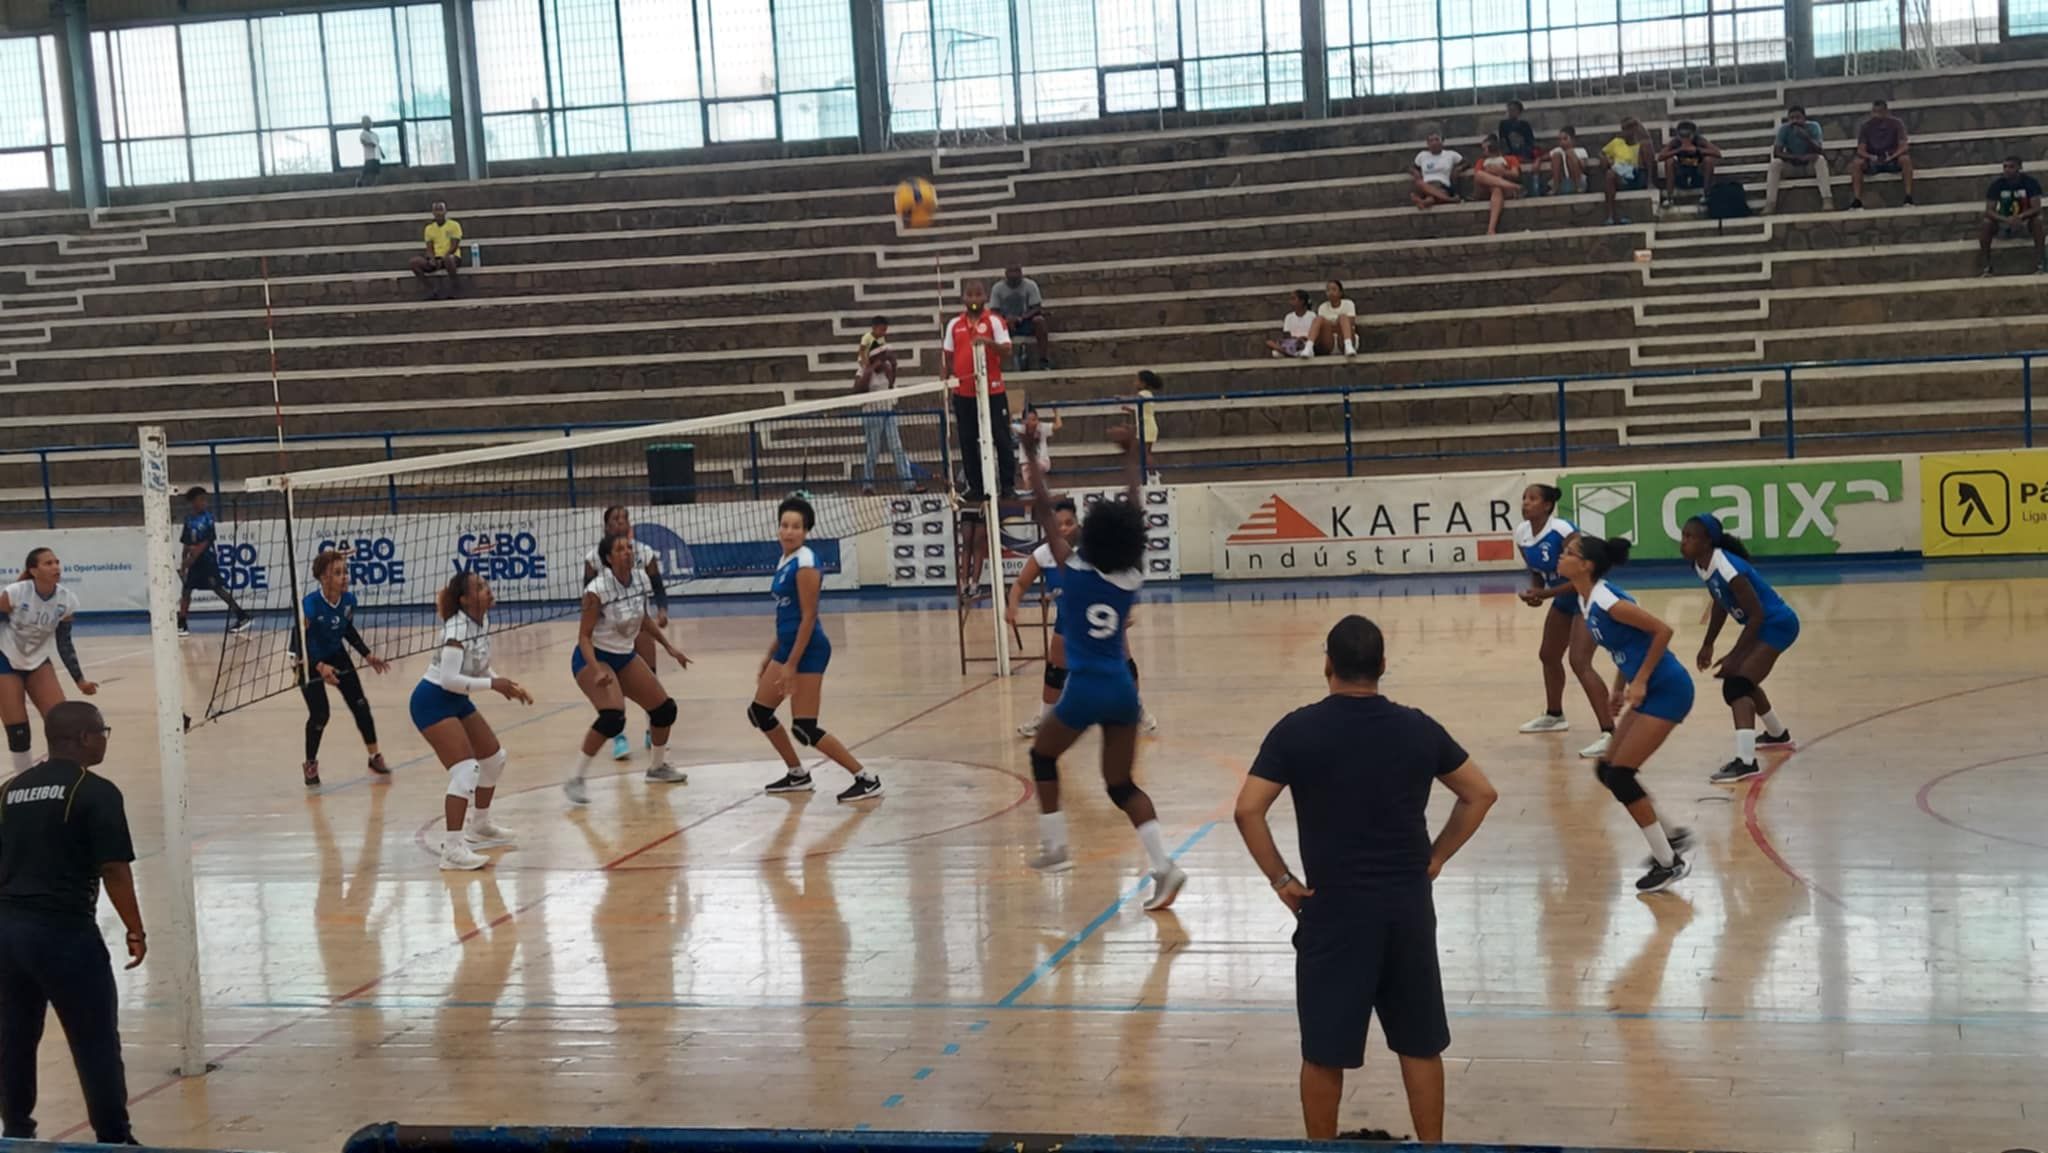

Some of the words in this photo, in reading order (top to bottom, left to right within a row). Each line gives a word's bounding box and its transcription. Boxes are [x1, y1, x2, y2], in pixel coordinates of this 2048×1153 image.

[1332, 500, 1513, 537] KAFAR
[2022, 510, 2047, 524] Liga
[217, 543, 257, 567] BO
[457, 532, 538, 558] CABO
[1225, 543, 1467, 570] Indústria
[218, 566, 269, 590] RDE
[349, 560, 406, 586] RDE
[452, 555, 547, 580] VERDE
[1085, 603, 1120, 640] 9
[6, 785, 66, 805] VOLEIBOL
